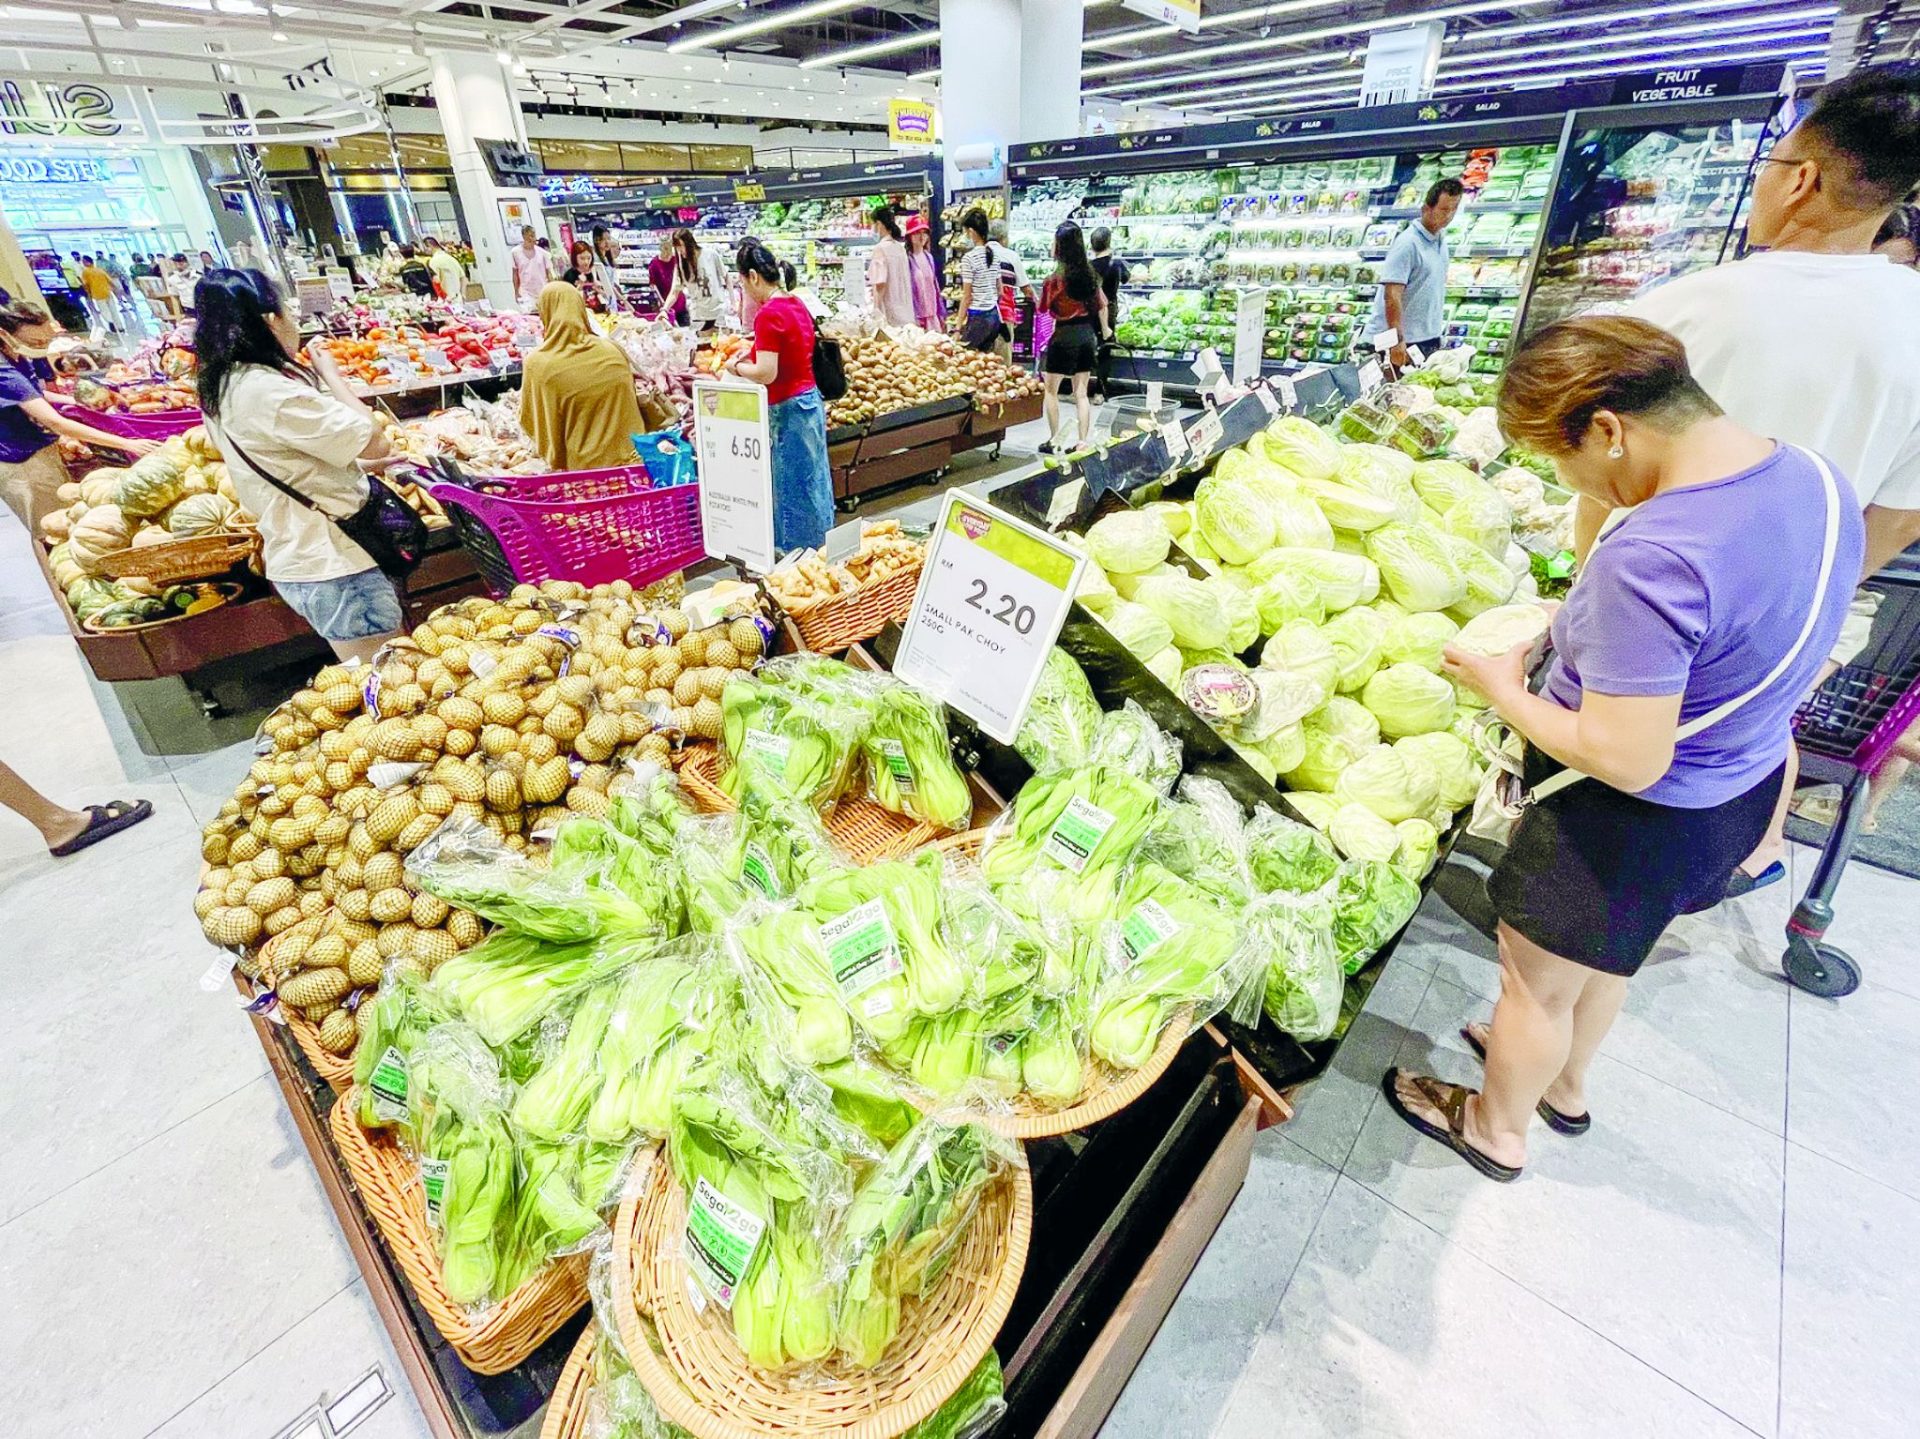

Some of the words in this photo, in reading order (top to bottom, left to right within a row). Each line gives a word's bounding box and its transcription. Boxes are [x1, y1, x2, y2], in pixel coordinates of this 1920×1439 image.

[1655, 69, 1701, 84] FRUIT
[1632, 84, 1718, 102] VEGETABLE
[1474, 102, 1500, 112] SALAD
[1301, 121, 1321, 129] SALAD
[731, 435, 761, 460] 6.50
[940, 558, 954, 570] RM
[964, 578, 1036, 635] 2.20
[920, 615, 944, 635] 250G
[924, 603, 953, 627] SMALL
[954, 620, 973, 638] PAK
[976, 634, 1006, 655] CHOY
